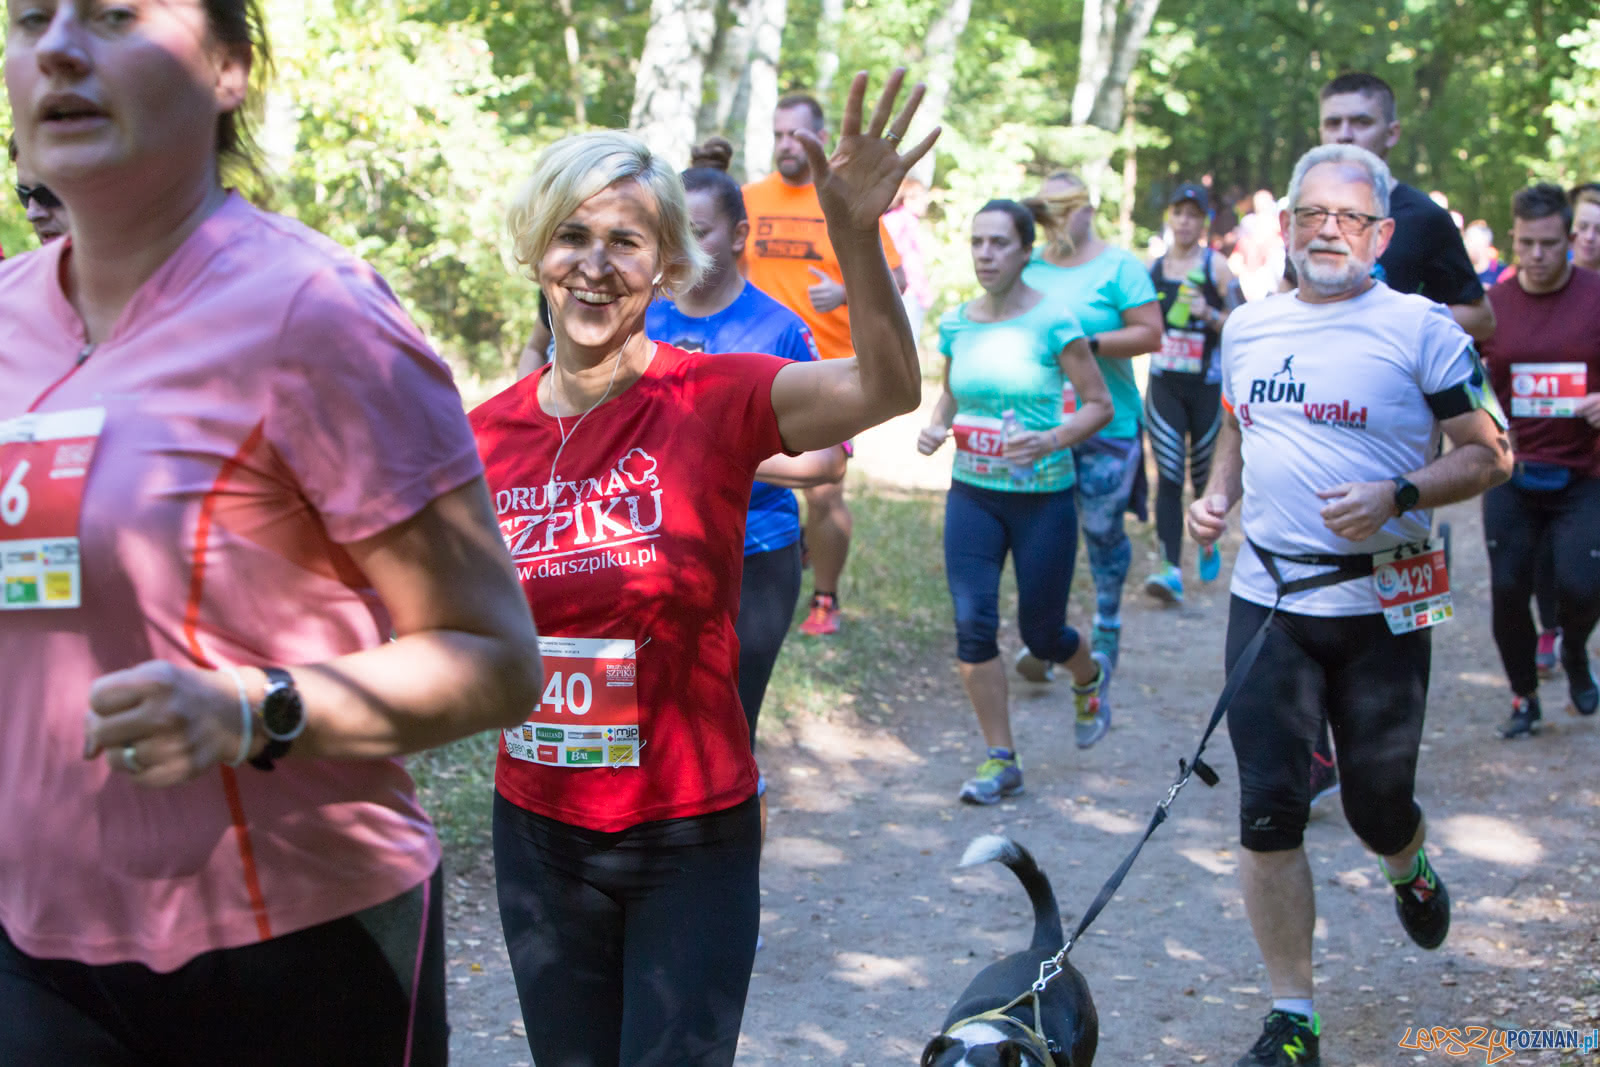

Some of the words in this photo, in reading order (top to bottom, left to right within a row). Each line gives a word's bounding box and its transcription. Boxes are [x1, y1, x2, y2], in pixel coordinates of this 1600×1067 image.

[1249, 379, 1306, 403] RUN
[1303, 399, 1368, 423] wald
[967, 431, 1002, 456] 457
[0, 459, 31, 526] 6
[496, 468, 629, 515] DRUŻYNA
[499, 489, 663, 556] SZPIKU
[516, 544, 657, 581] w.darszpiku.pl
[1399, 563, 1432, 597] 429
[533, 671, 593, 716] 40
[616, 728, 638, 738] mjp
